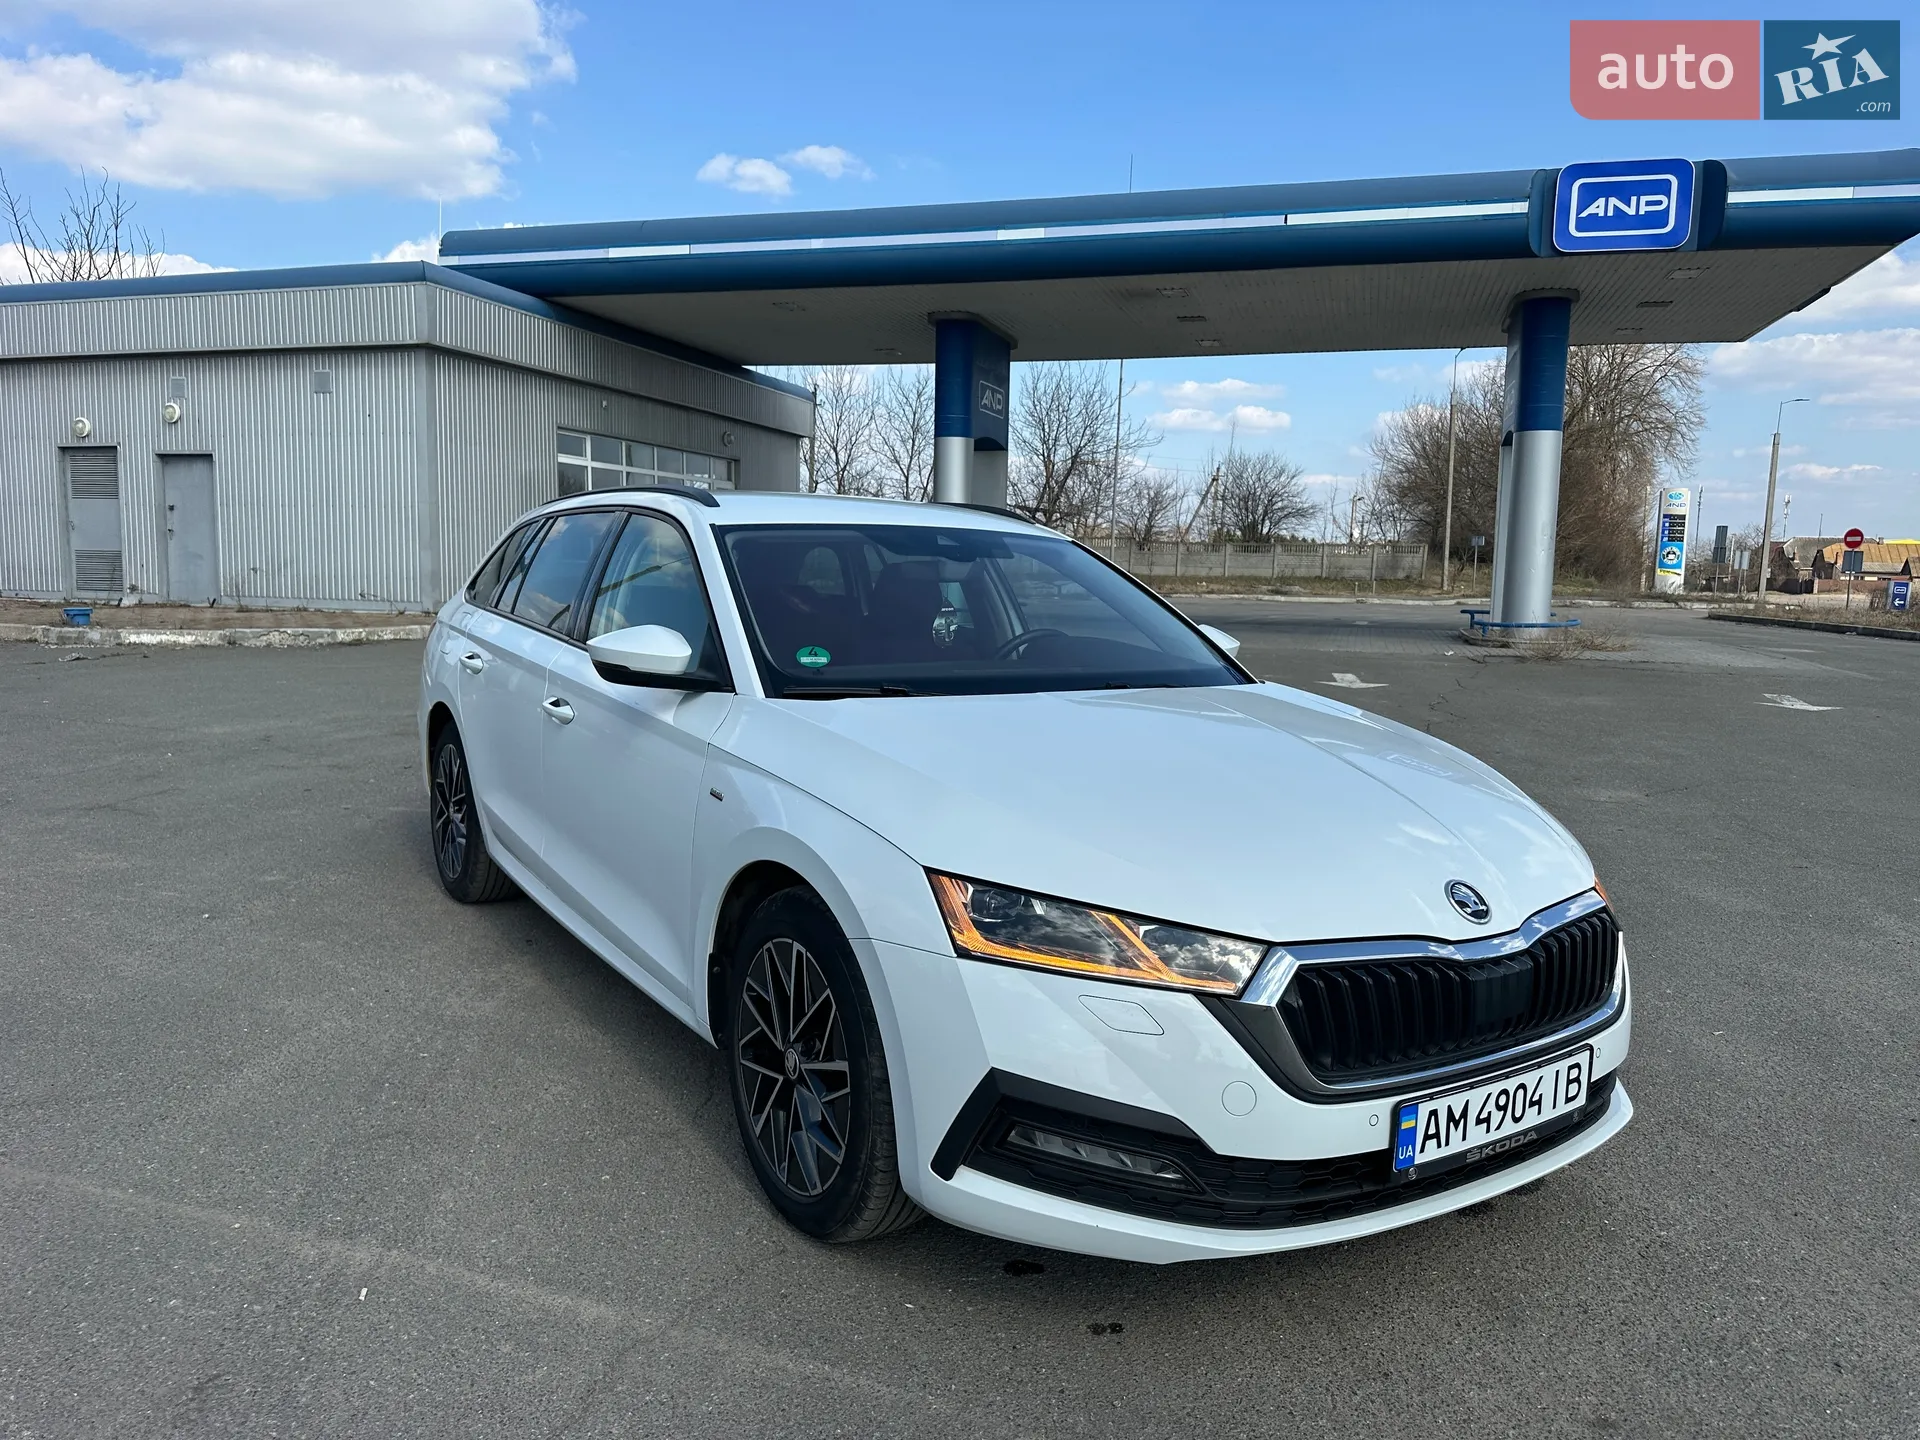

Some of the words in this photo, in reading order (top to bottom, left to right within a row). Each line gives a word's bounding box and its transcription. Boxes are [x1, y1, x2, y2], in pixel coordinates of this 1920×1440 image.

[1578, 194, 1669, 218] ANP
[981, 389, 1003, 410] ANP
[808, 646, 819, 657] 4
[1419, 1099, 1470, 1154] AM
[1475, 1075, 1544, 1134] 4904
[1552, 1061, 1582, 1110] IB
[1399, 1144, 1414, 1160] UA
[1466, 1130, 1538, 1162] ŠKODA
